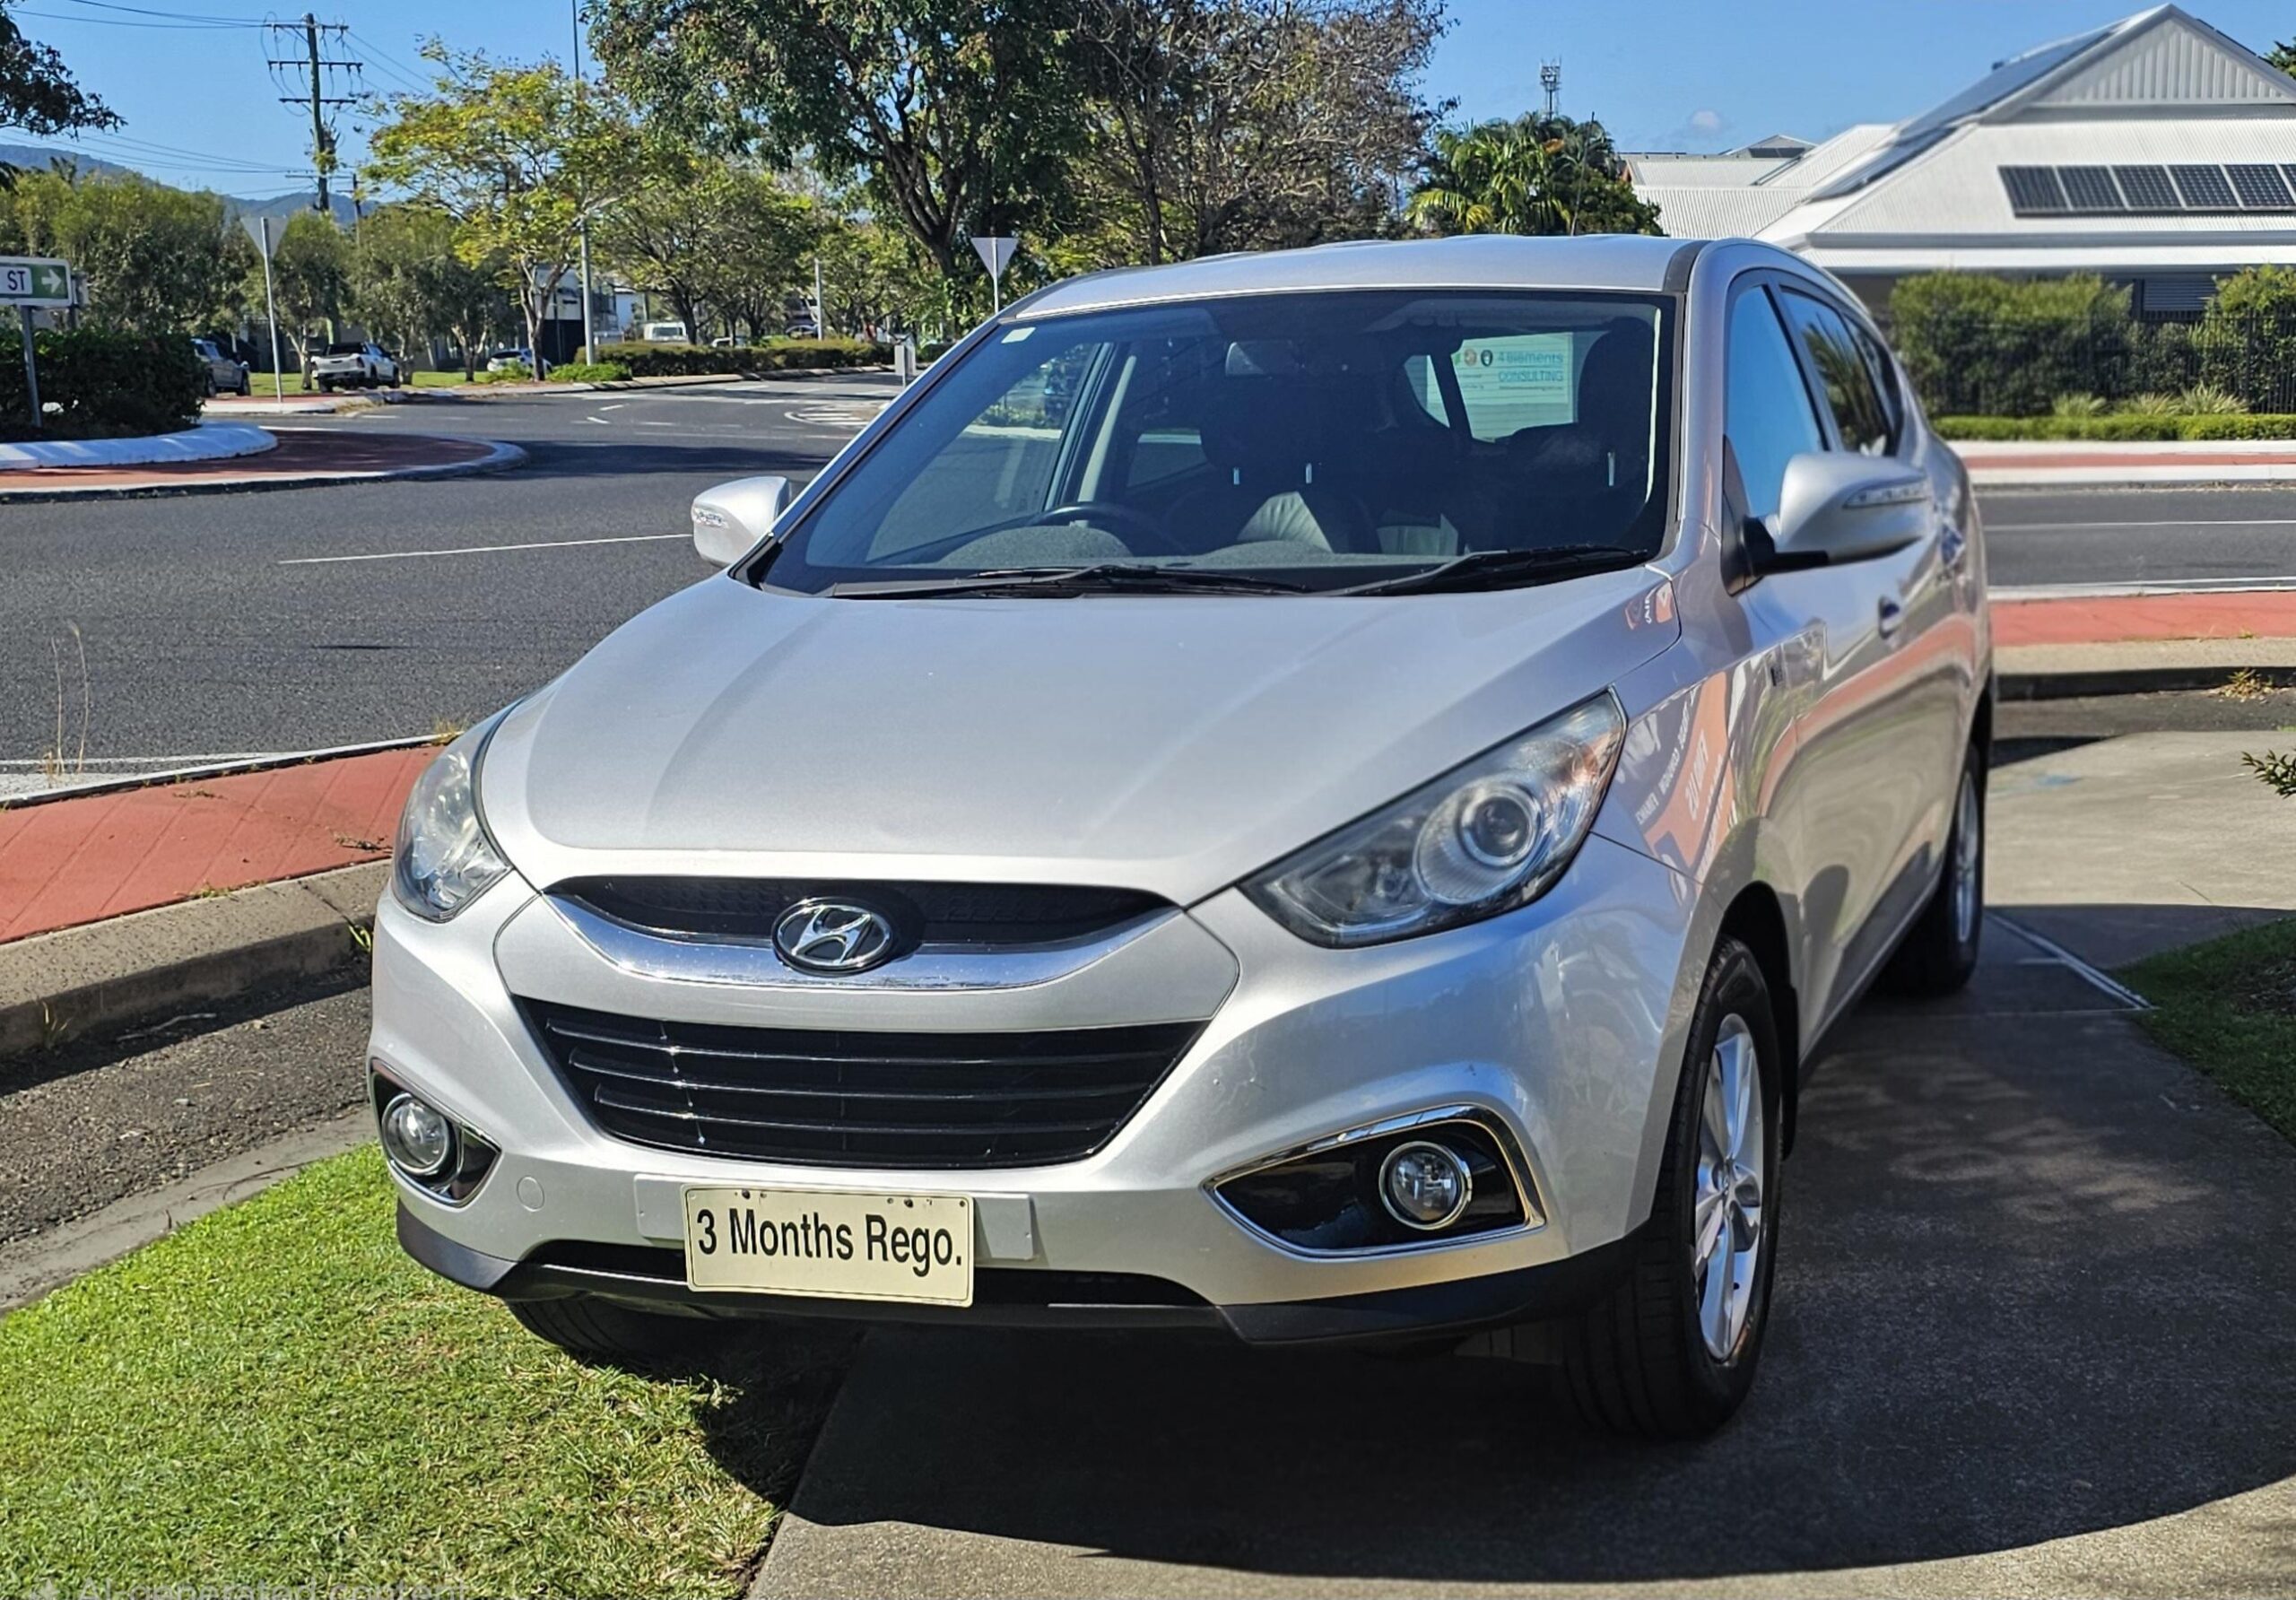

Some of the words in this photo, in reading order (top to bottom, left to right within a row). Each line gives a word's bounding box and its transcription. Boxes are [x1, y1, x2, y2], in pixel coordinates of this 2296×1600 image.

[7, 270, 26, 291] ST
[697, 1209, 718, 1255] 3
[729, 1208, 854, 1260] Months
[865, 1213, 961, 1277] Rego.
